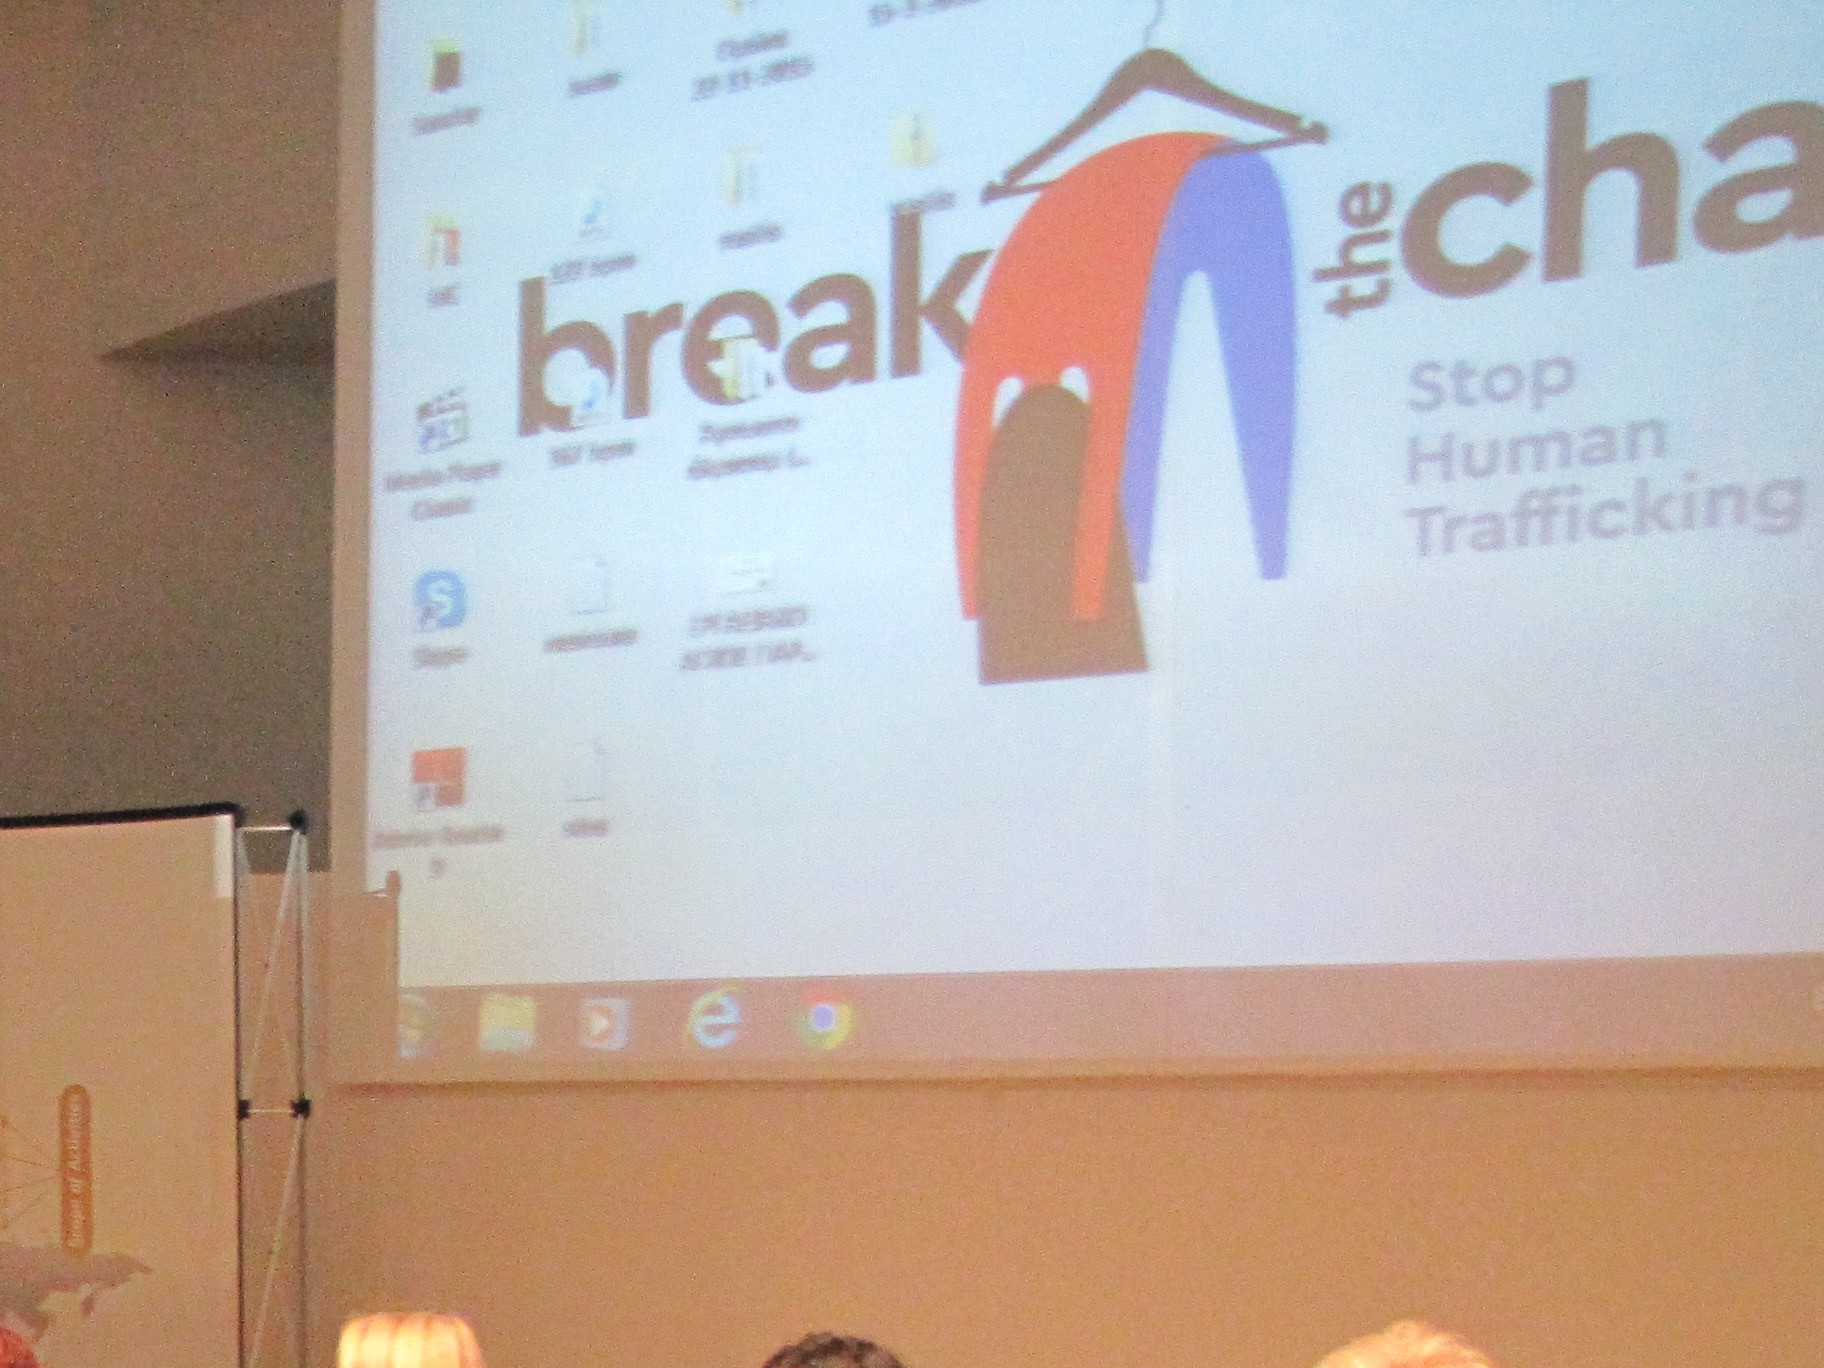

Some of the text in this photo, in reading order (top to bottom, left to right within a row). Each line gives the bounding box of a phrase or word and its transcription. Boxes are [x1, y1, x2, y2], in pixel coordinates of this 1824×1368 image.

[1313, 180, 1397, 319] the
[518, 204, 994, 437] break
[1407, 355, 1577, 412] Stop
[1406, 418, 1668, 486] Human
[1403, 471, 1808, 557] Trafficking
